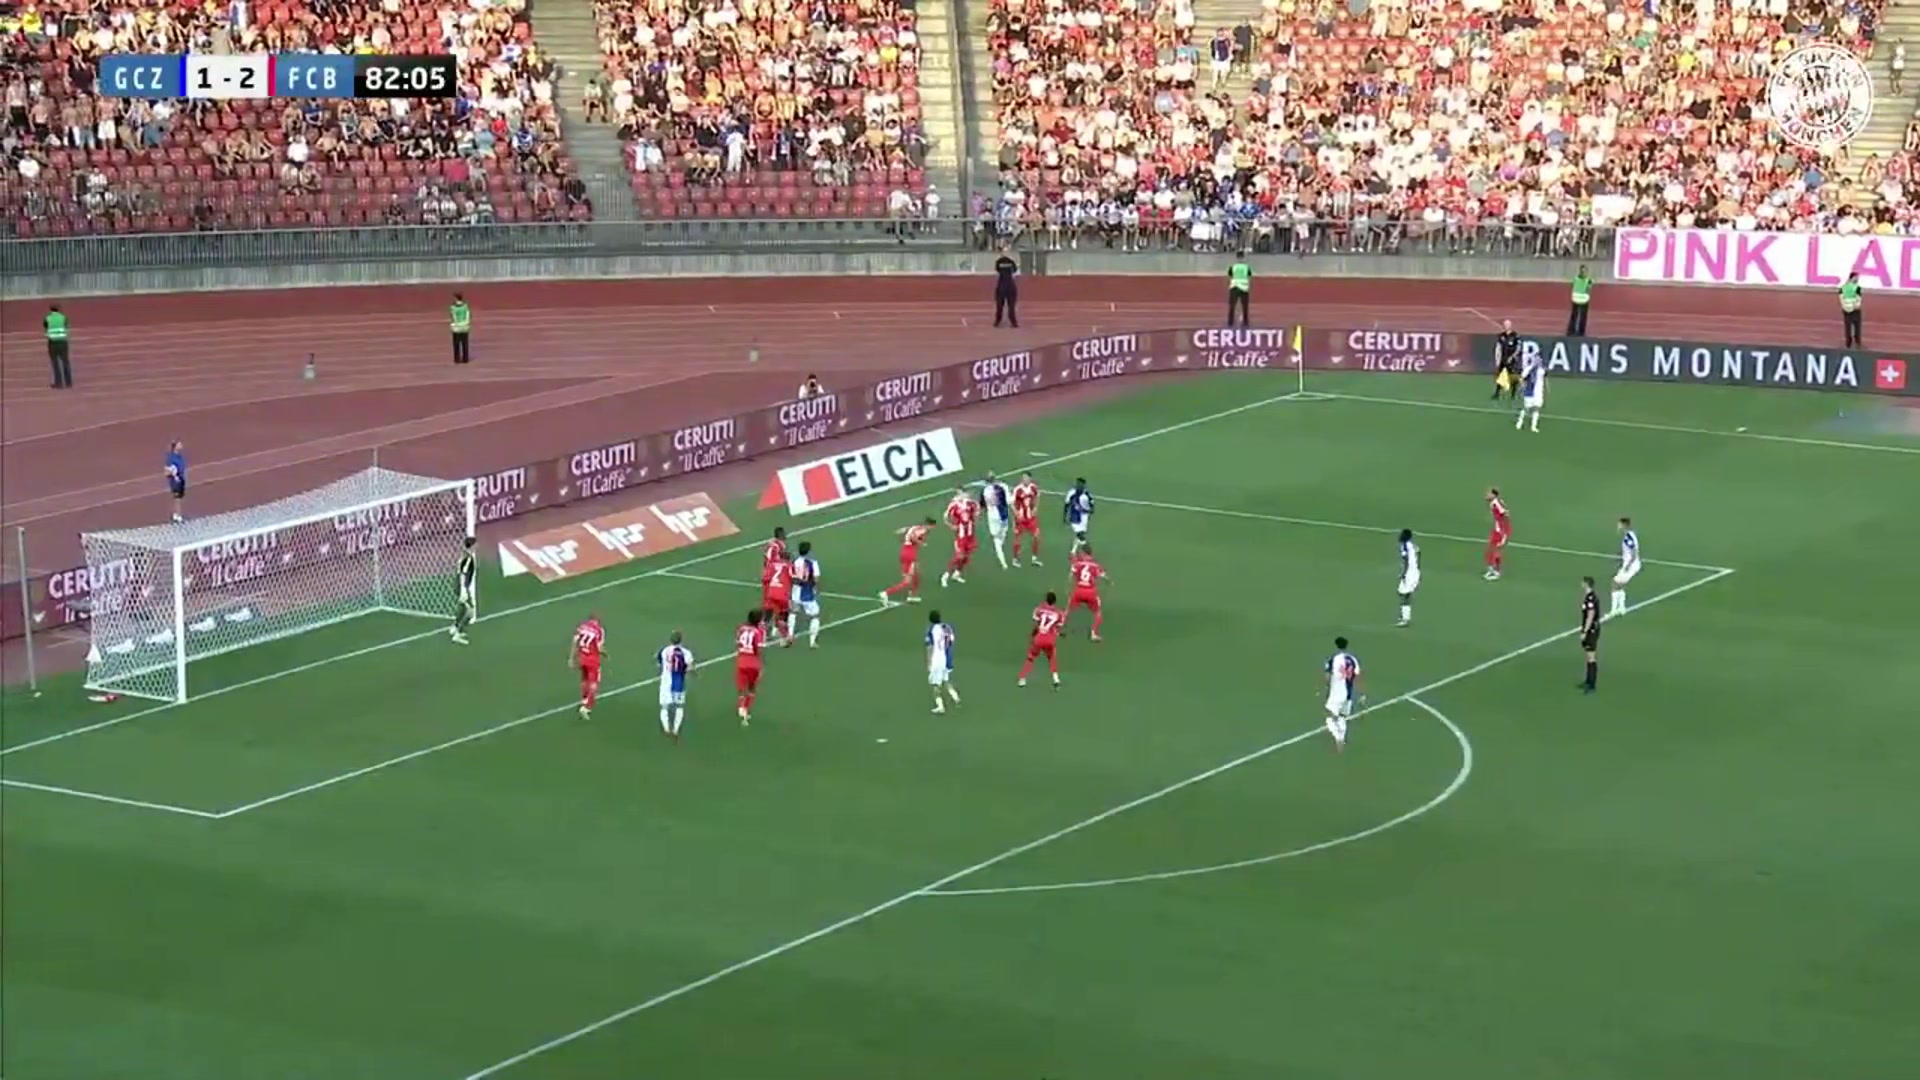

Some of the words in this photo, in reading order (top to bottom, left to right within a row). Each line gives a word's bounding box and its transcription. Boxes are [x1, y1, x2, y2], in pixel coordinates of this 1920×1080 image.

[1618, 230, 1779, 283] PINK
[1072, 334, 1136, 360] CERUTTI
[1193, 328, 1284, 348] CERUTTI
[1349, 329, 1442, 351] CERUTTI
[972, 352, 1030, 381] CERUTTI
[1653, 345, 1858, 387] MONTANA
[876, 371, 931, 401] CERUTTI
[779, 394, 836, 425] CERUTTI
[673, 419, 735, 451] CERUTTI
[571, 441, 635, 476] CERUTTI
[835, 437, 944, 496] ELCA
[456, 467, 526, 502] CRUTTI
[1079, 565, 1091, 582] 6
[1038, 613, 1058, 632] 17
